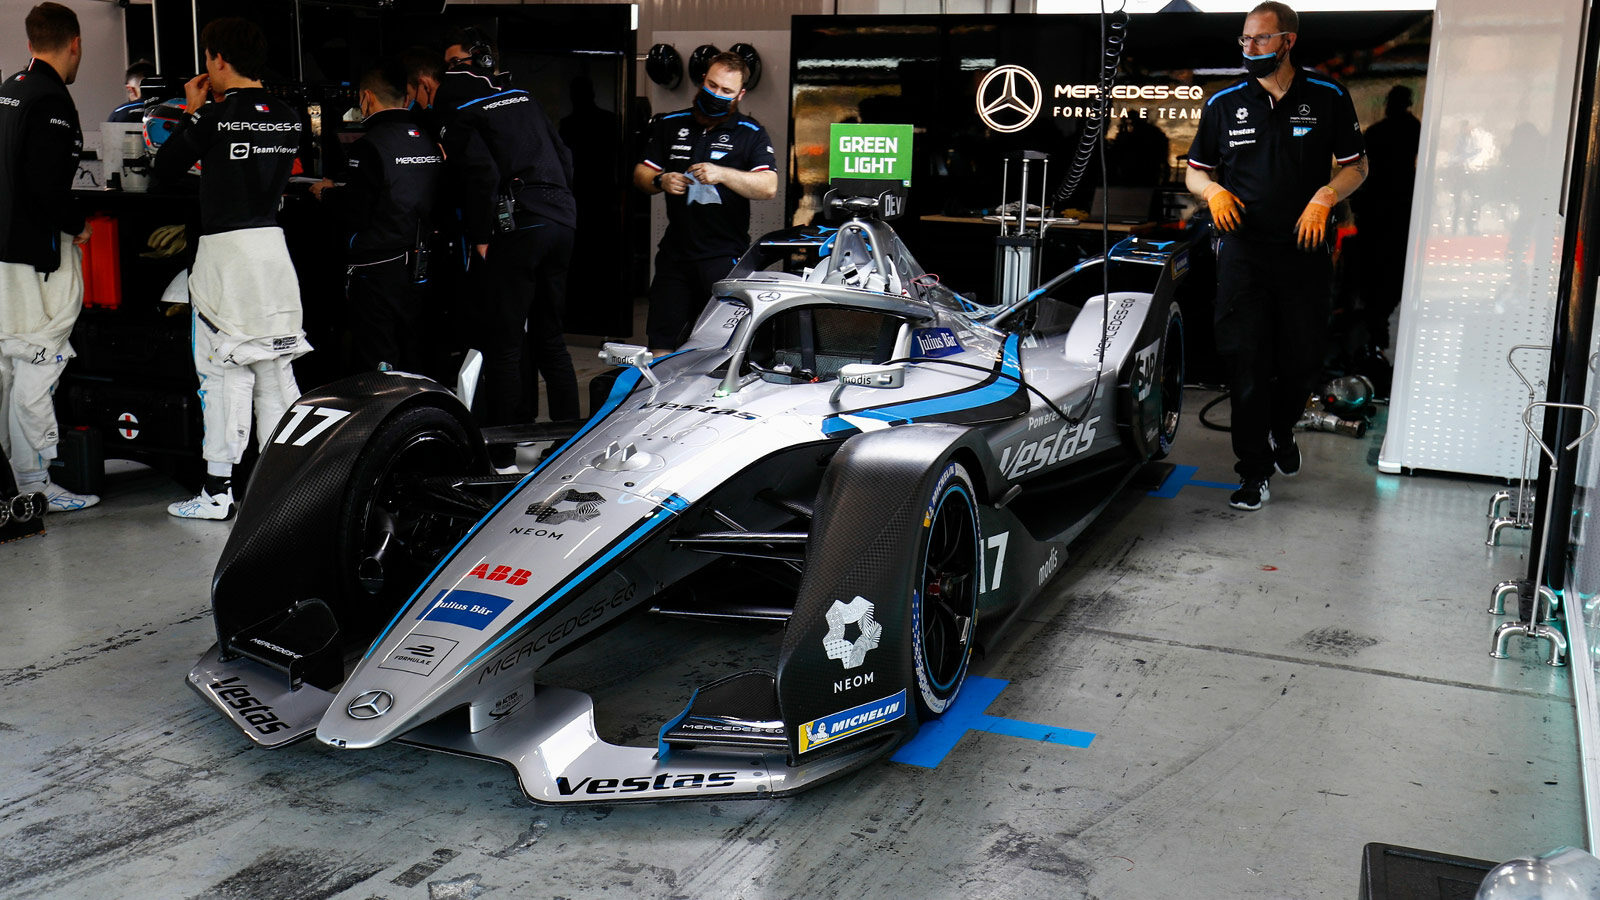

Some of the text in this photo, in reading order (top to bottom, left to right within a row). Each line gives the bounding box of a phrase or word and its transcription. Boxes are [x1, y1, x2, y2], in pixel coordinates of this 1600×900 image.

[1140, 107, 1148, 119] E
[1160, 107, 1202, 120] TEAM
[839, 136, 898, 154] GREEN
[844, 156, 897, 174] LIGHT
[884, 194, 902, 217] DEV
[917, 332, 957, 355] Julius Bär
[611, 355, 634, 365] modis
[841, 373, 871, 385] modis
[274, 404, 352, 447] 17
[998, 415, 1101, 481] Vestas
[509, 527, 564, 541] NEOM
[464, 563, 532, 586] ABB
[1037, 546, 1059, 587] modis
[469, 604, 493, 616] Bär
[478, 582, 636, 685] MERCEDES-EQ
[833, 671, 874, 694] NEOM
[209, 676, 291, 735] Vestas
[682, 723, 784, 734] MERCEDES-EQ
[831, 702, 899, 733] MICHELIN
[556, 771, 738, 796] Vestas
